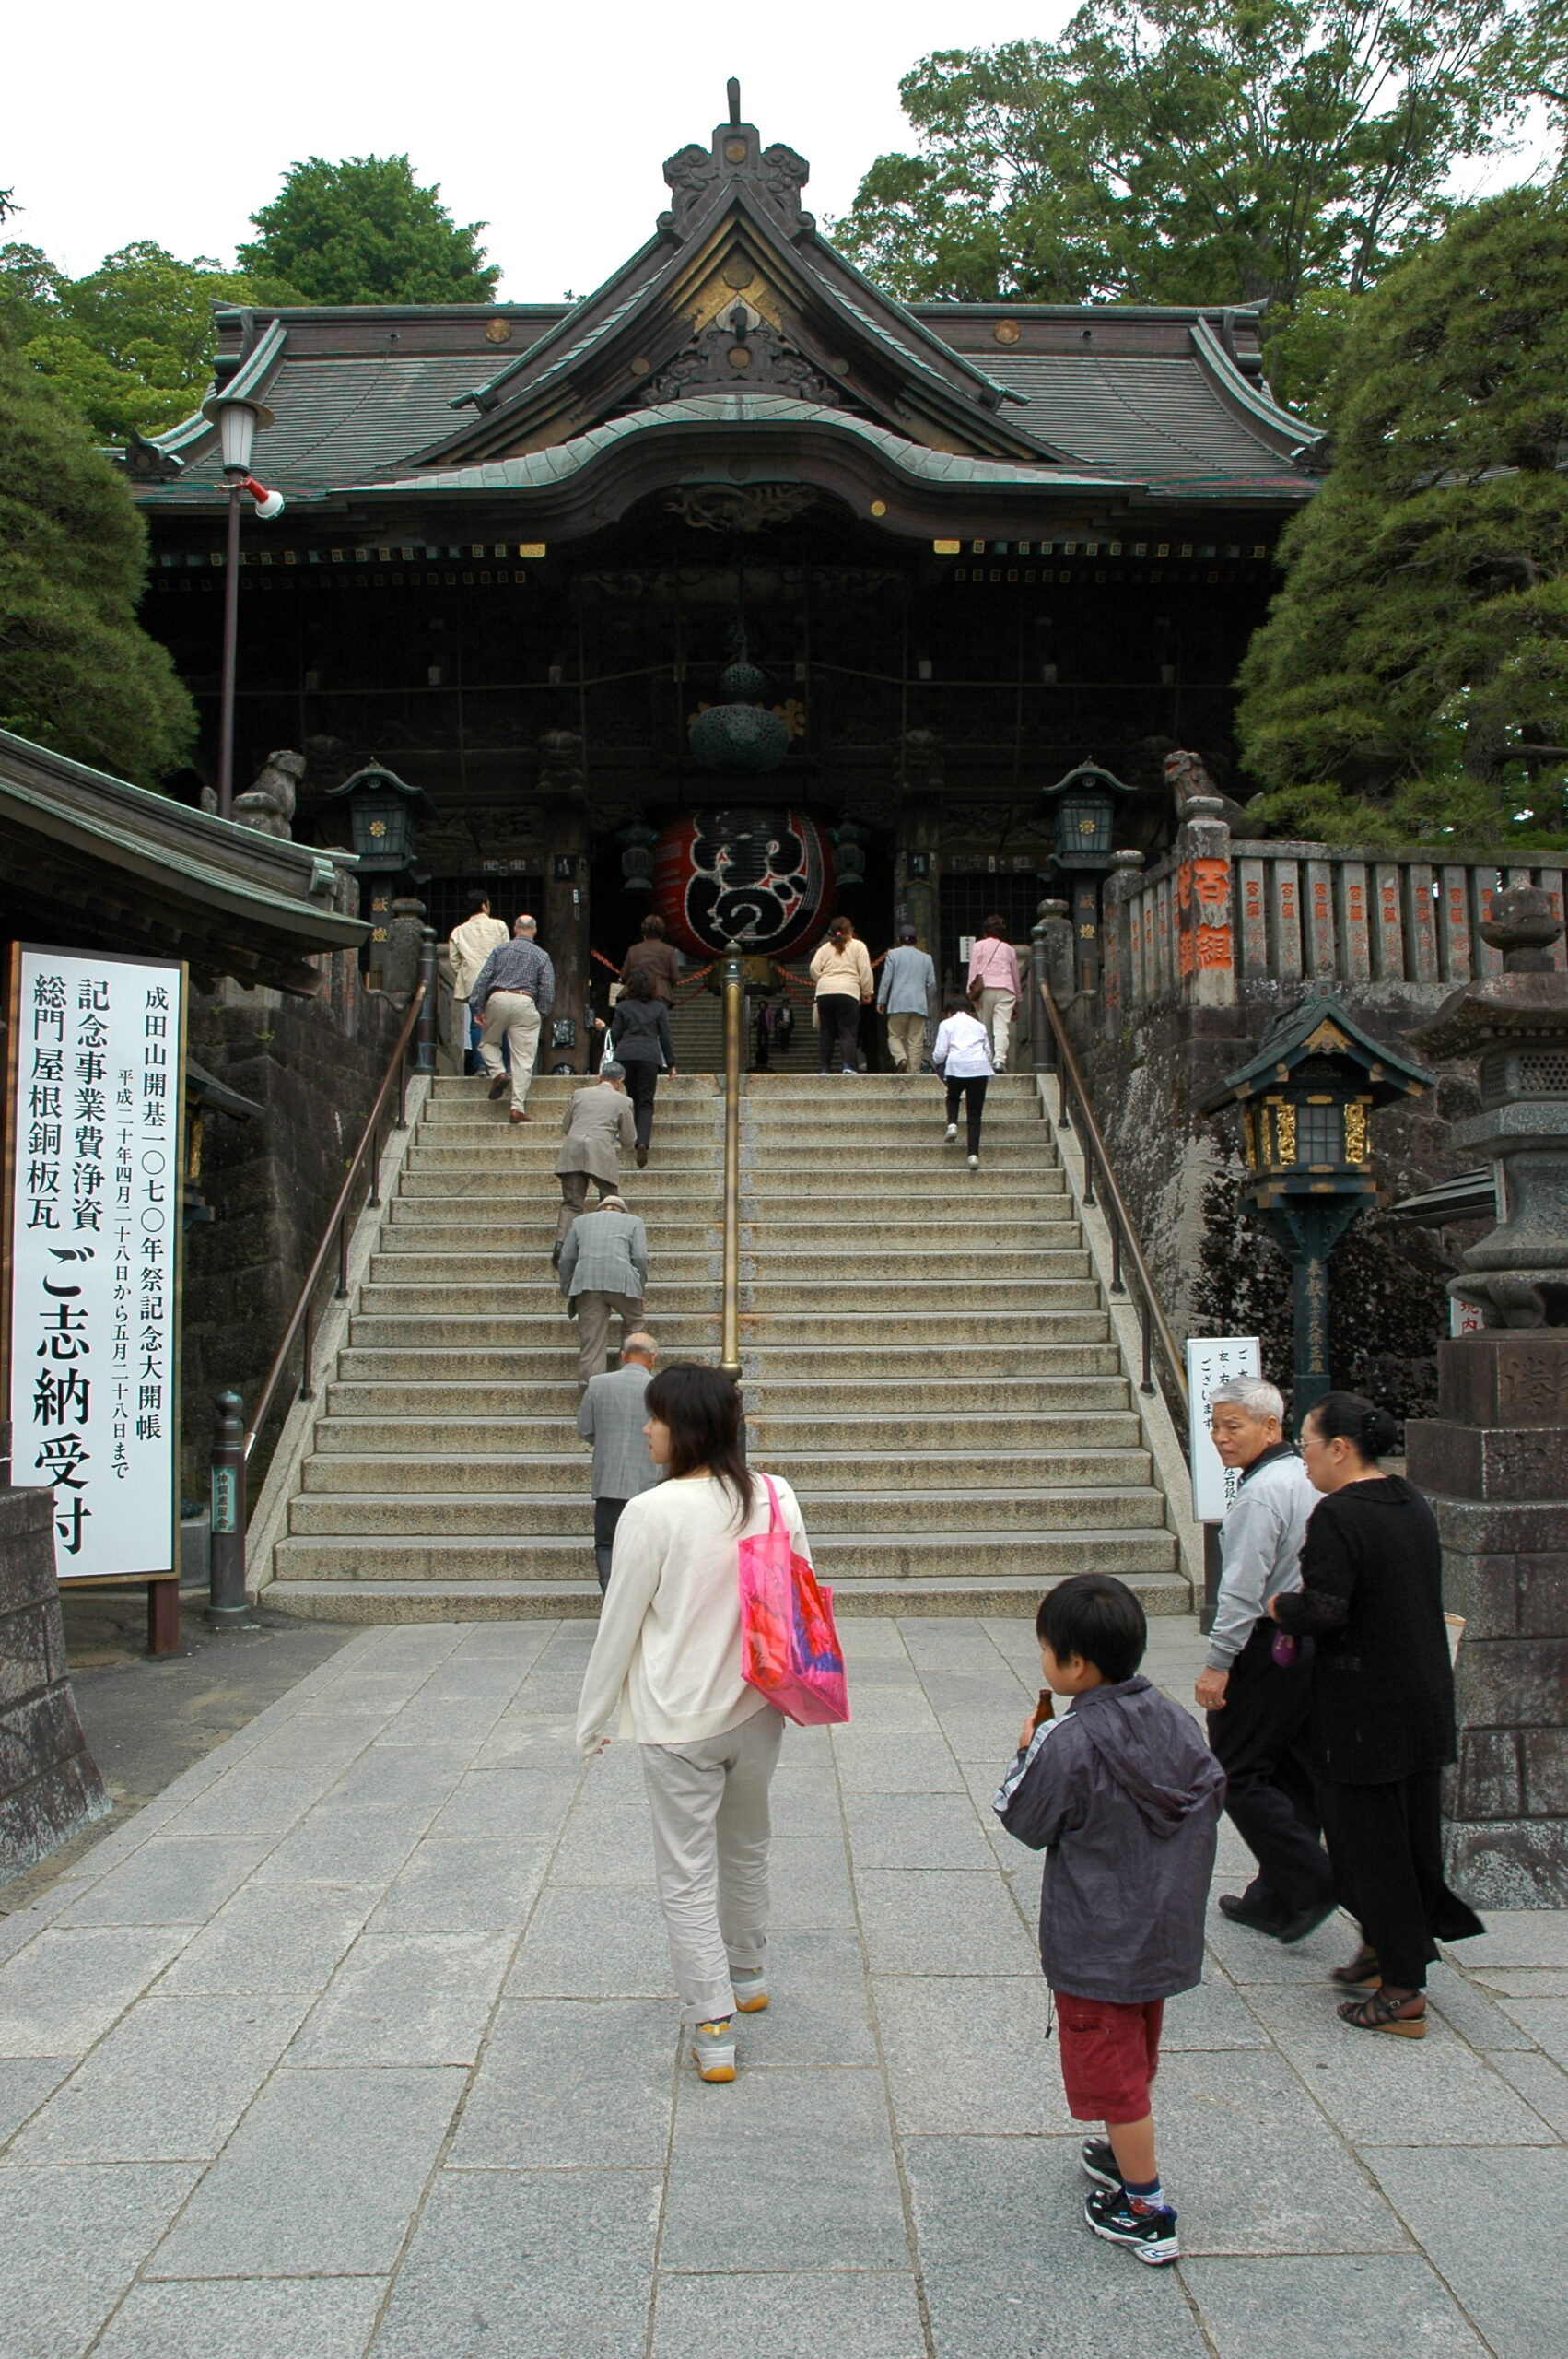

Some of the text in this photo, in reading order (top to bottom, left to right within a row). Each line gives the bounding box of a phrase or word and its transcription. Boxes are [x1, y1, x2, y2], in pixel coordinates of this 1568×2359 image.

[27, 973, 67, 1230] 総門屋根銅板瓦
[71, 979, 111, 1232] 記念事業費浄資
[33, 1246, 95, 1555] ご志納受付
[111, 1069, 134, 1480] 平成二十年四月二十八日から五月二十八日まで
[1200, 1358, 1212, 1430] ございます
